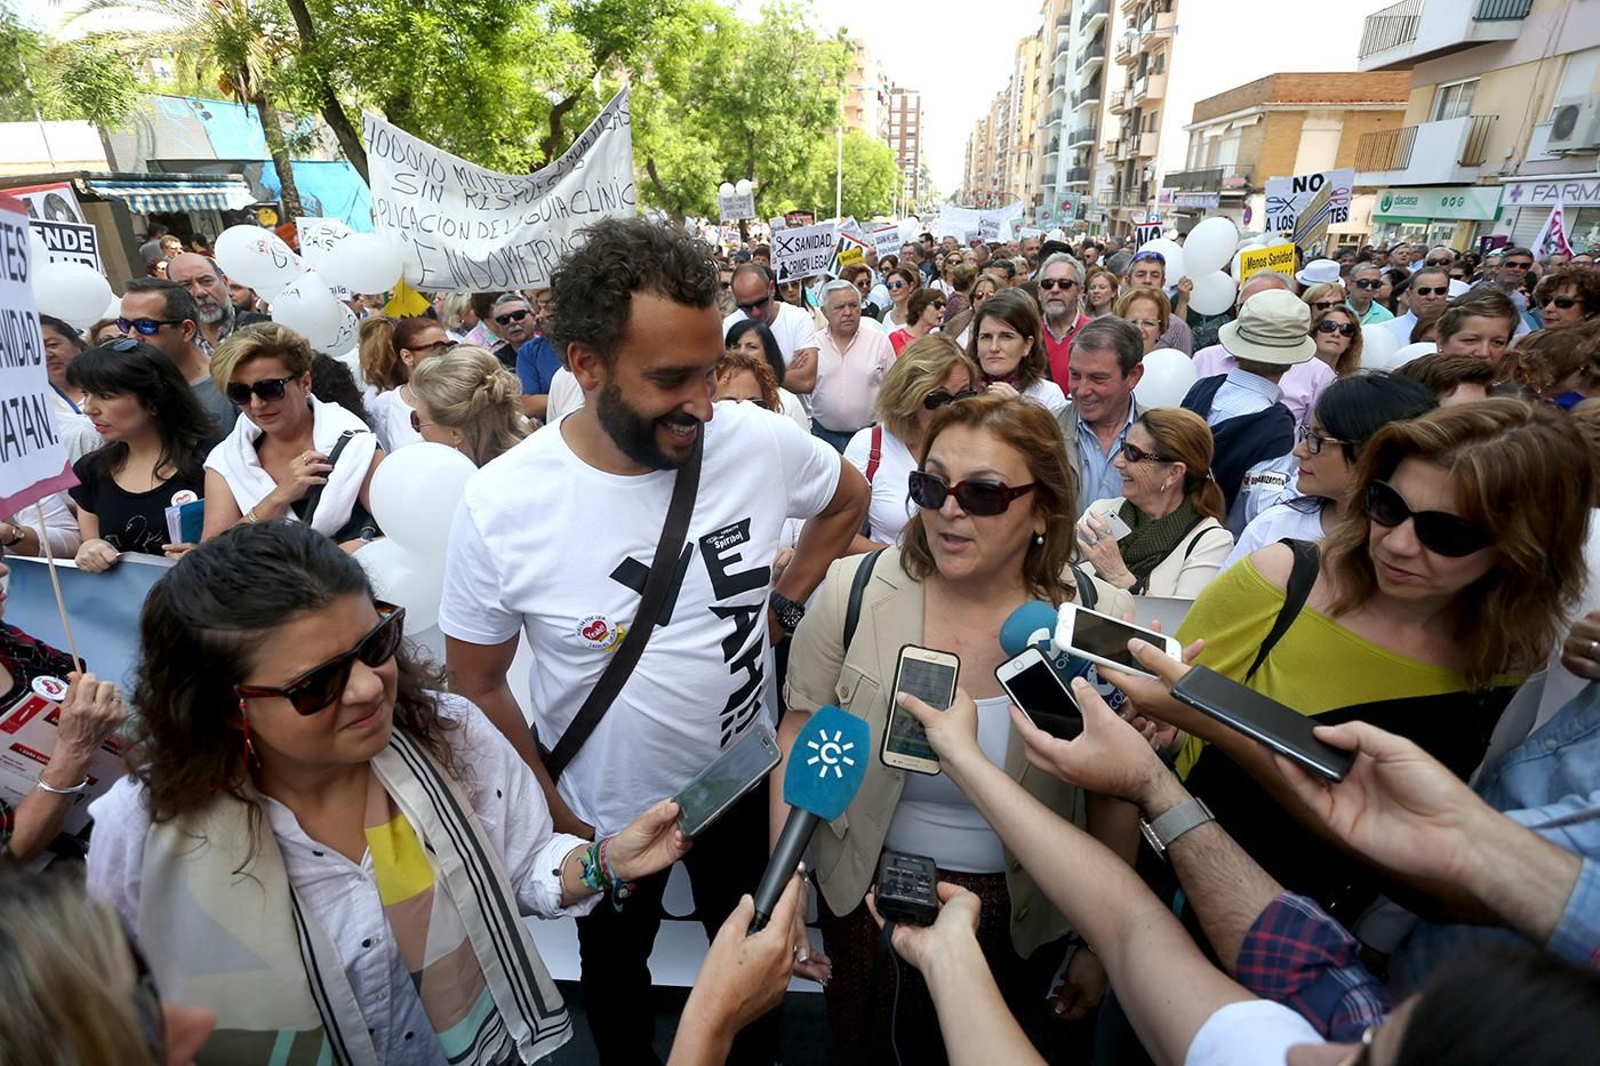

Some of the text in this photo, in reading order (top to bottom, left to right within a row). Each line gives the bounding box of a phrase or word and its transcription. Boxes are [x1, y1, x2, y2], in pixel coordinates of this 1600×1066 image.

[391, 172, 443, 203] SIN
[1292, 173, 1325, 194] NO
[1530, 183, 1600, 201] FARM
[1276, 215, 1294, 231] LOS
[794, 233, 832, 252] SANIDAD
[1269, 249, 1294, 266] Sanidad
